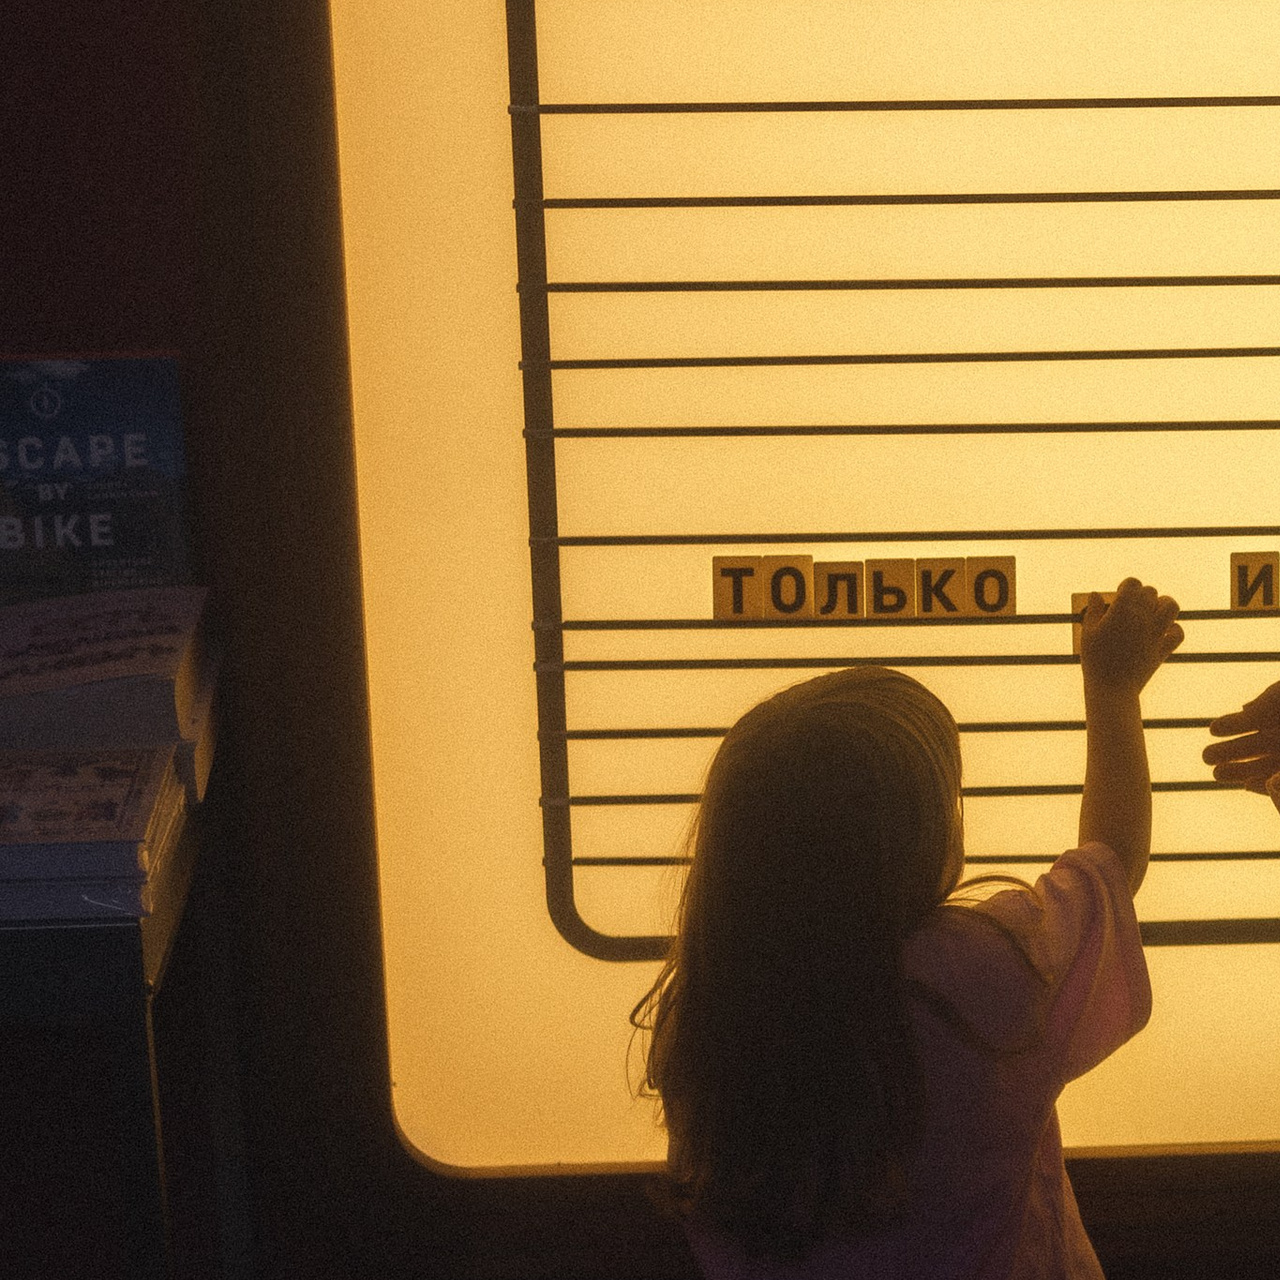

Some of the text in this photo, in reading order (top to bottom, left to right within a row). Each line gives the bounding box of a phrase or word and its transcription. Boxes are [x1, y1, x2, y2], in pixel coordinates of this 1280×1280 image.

[38, 483, 72, 501] BY
[0, 513, 113, 549] BIKE
[721, 566, 1009, 614] ТОЛЬКО
[1237, 563, 1274, 607] И
